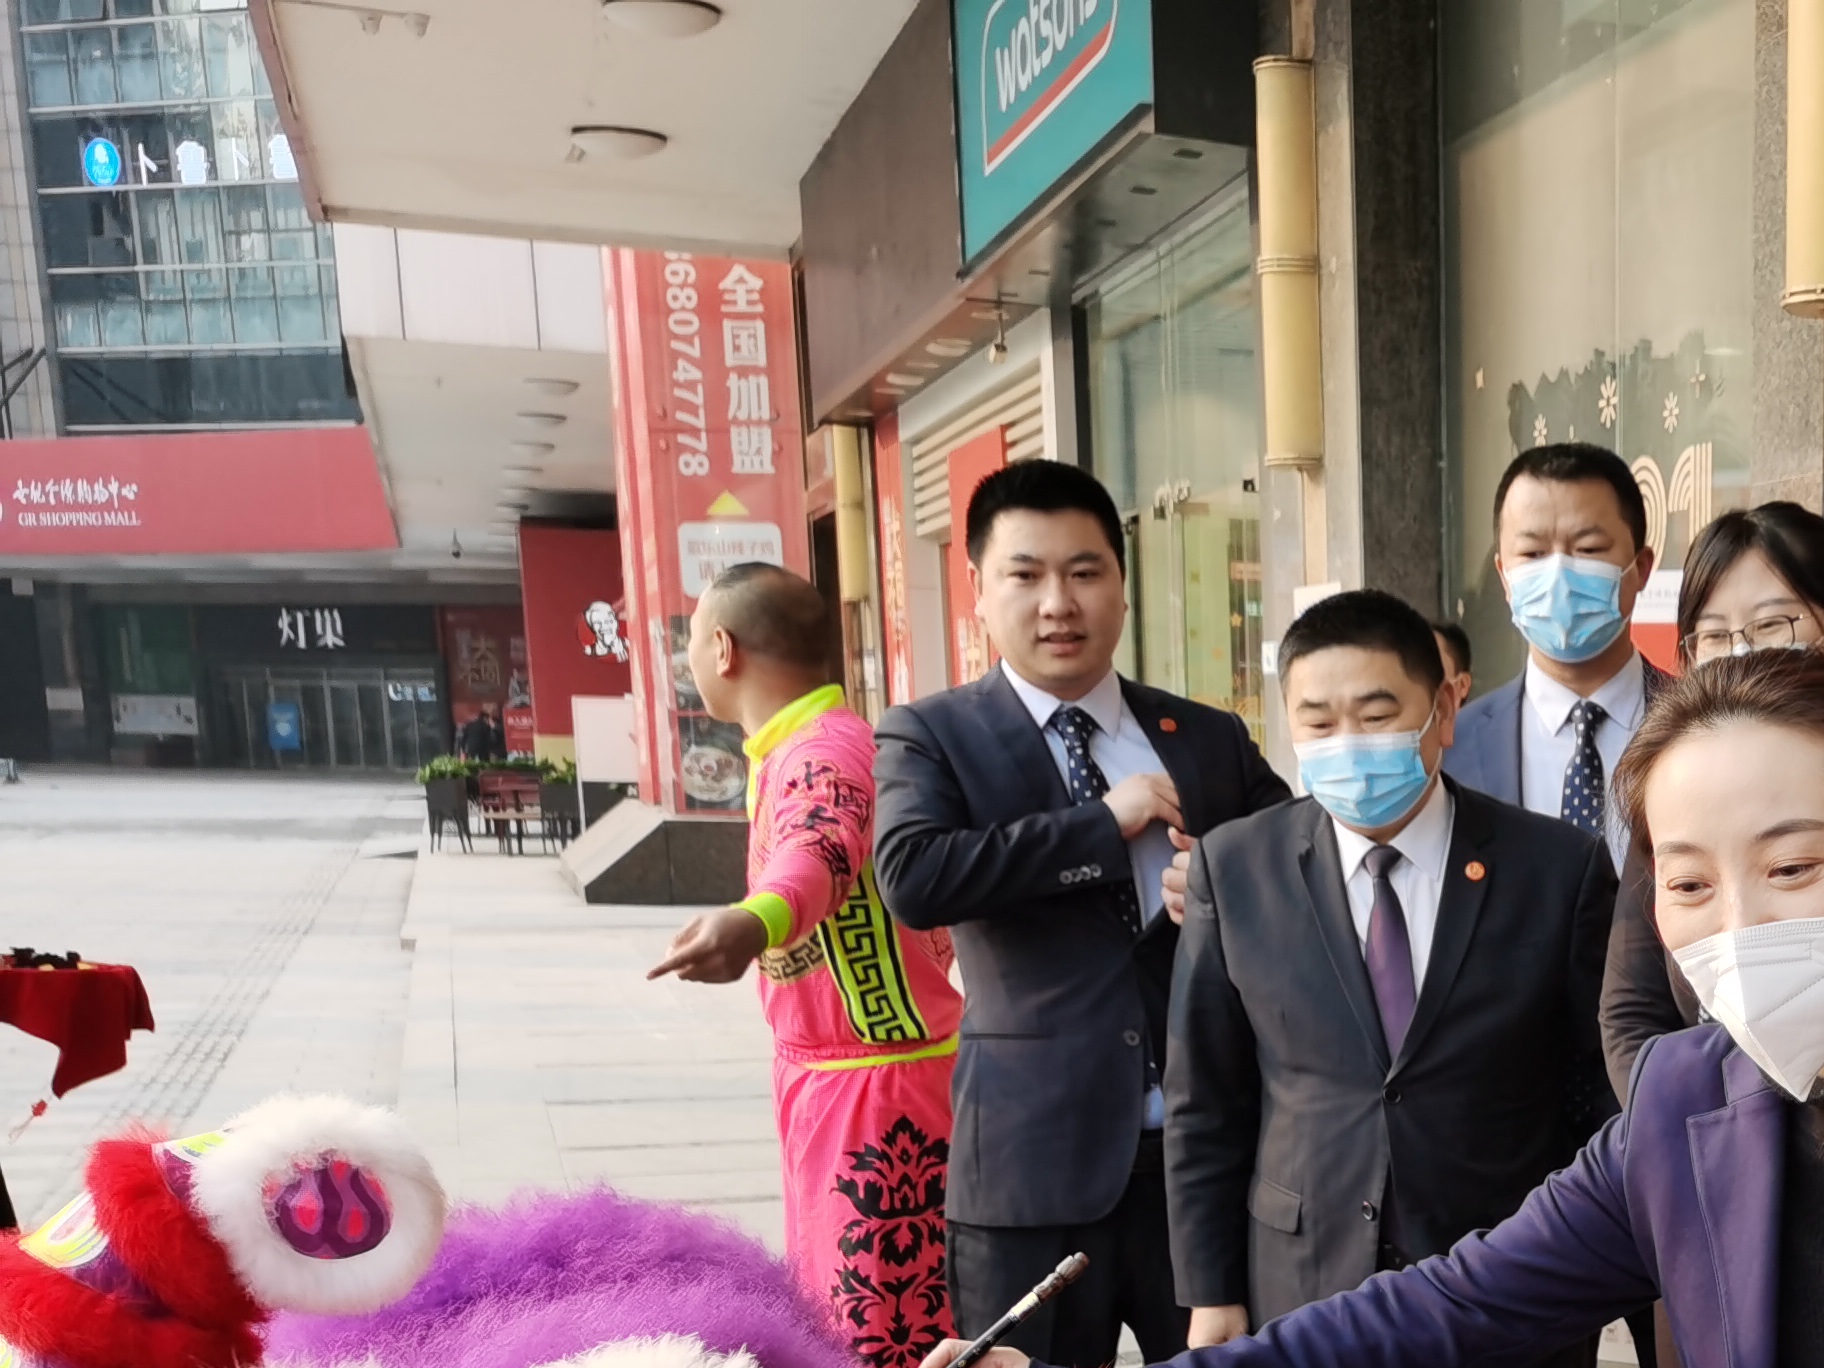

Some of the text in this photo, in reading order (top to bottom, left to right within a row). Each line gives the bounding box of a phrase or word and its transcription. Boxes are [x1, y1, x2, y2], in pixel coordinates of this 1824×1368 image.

[664, 250, 710, 477] 680747778
[718, 264, 775, 474] 全国加盟
[39, 511, 103, 527] SHOPPING
[104, 510, 140, 527] MALL
